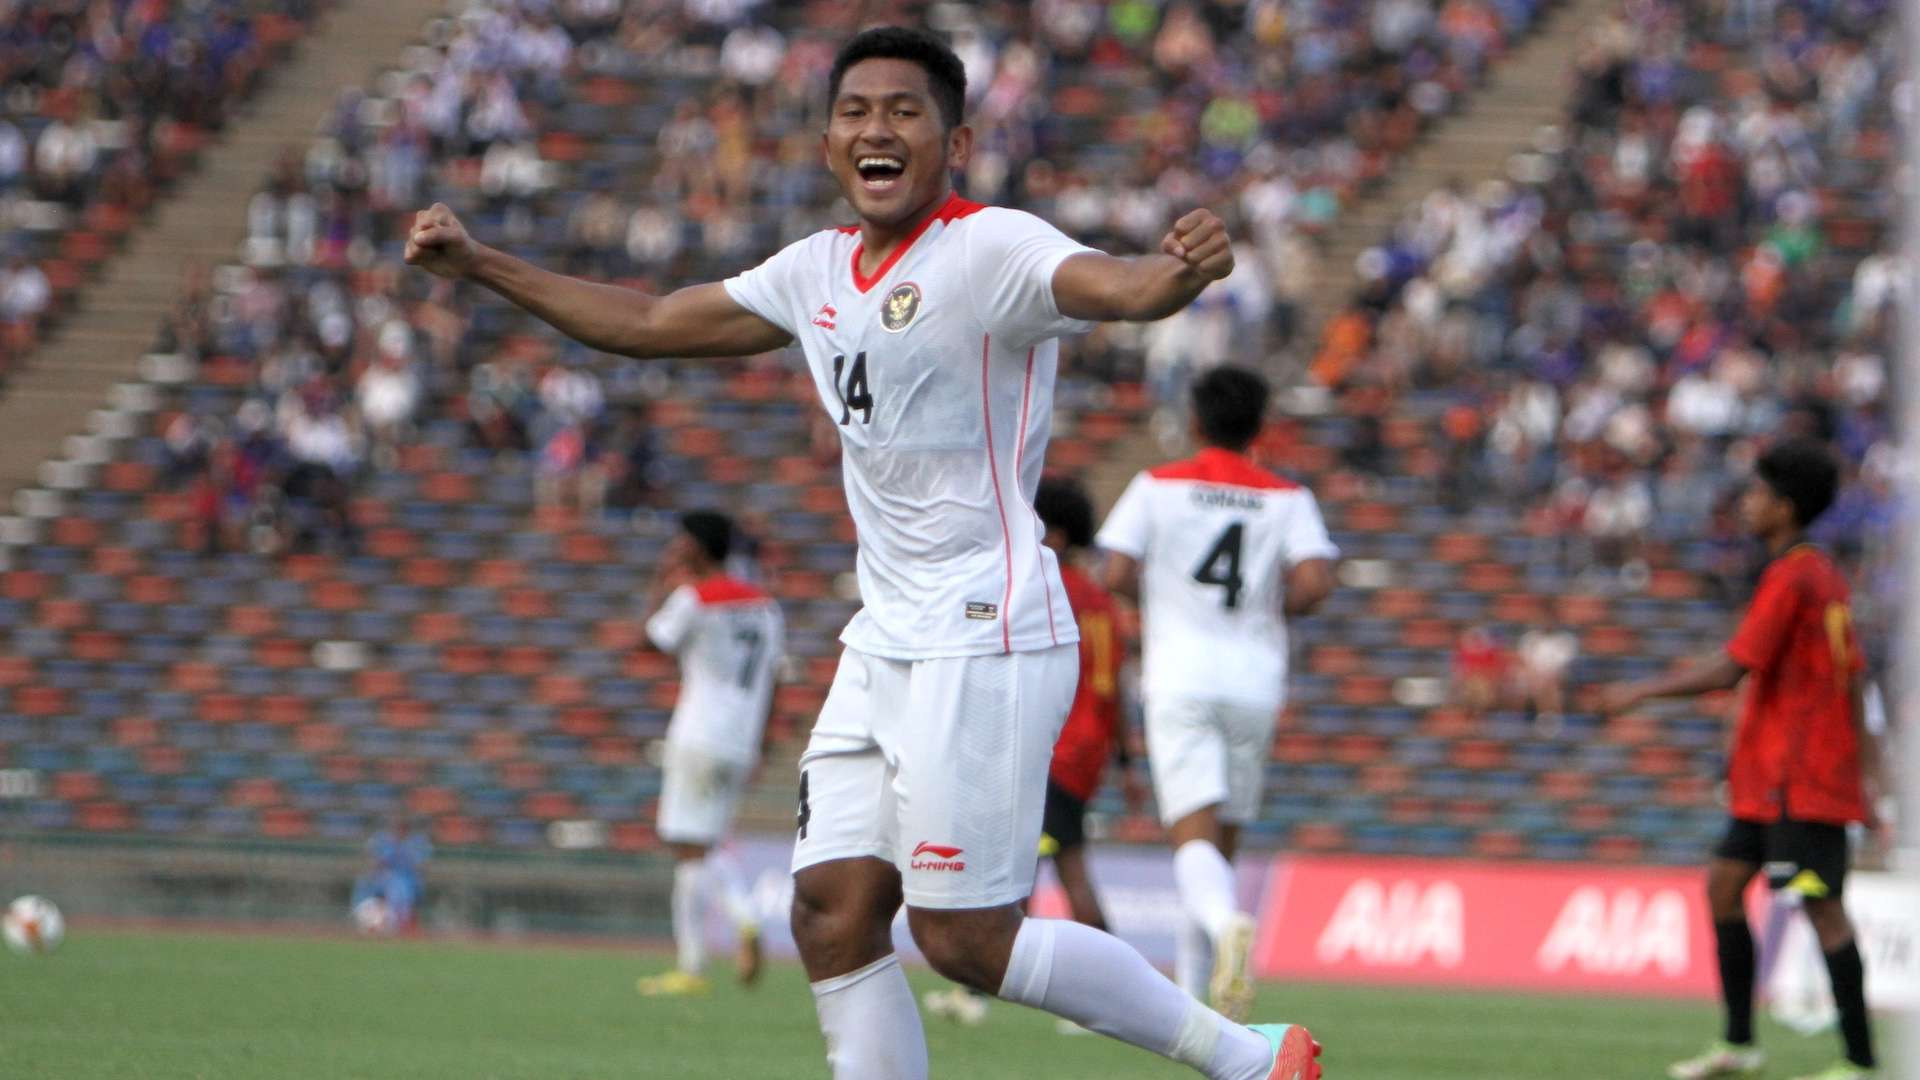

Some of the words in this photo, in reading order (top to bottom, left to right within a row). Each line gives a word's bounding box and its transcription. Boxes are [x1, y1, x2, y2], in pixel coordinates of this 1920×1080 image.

[833, 351, 874, 426] 14
[1193, 522, 1243, 608] 4
[911, 859, 965, 872] LI-NING
[1317, 880, 1465, 967] AIA
[1537, 888, 1692, 976] AIA
